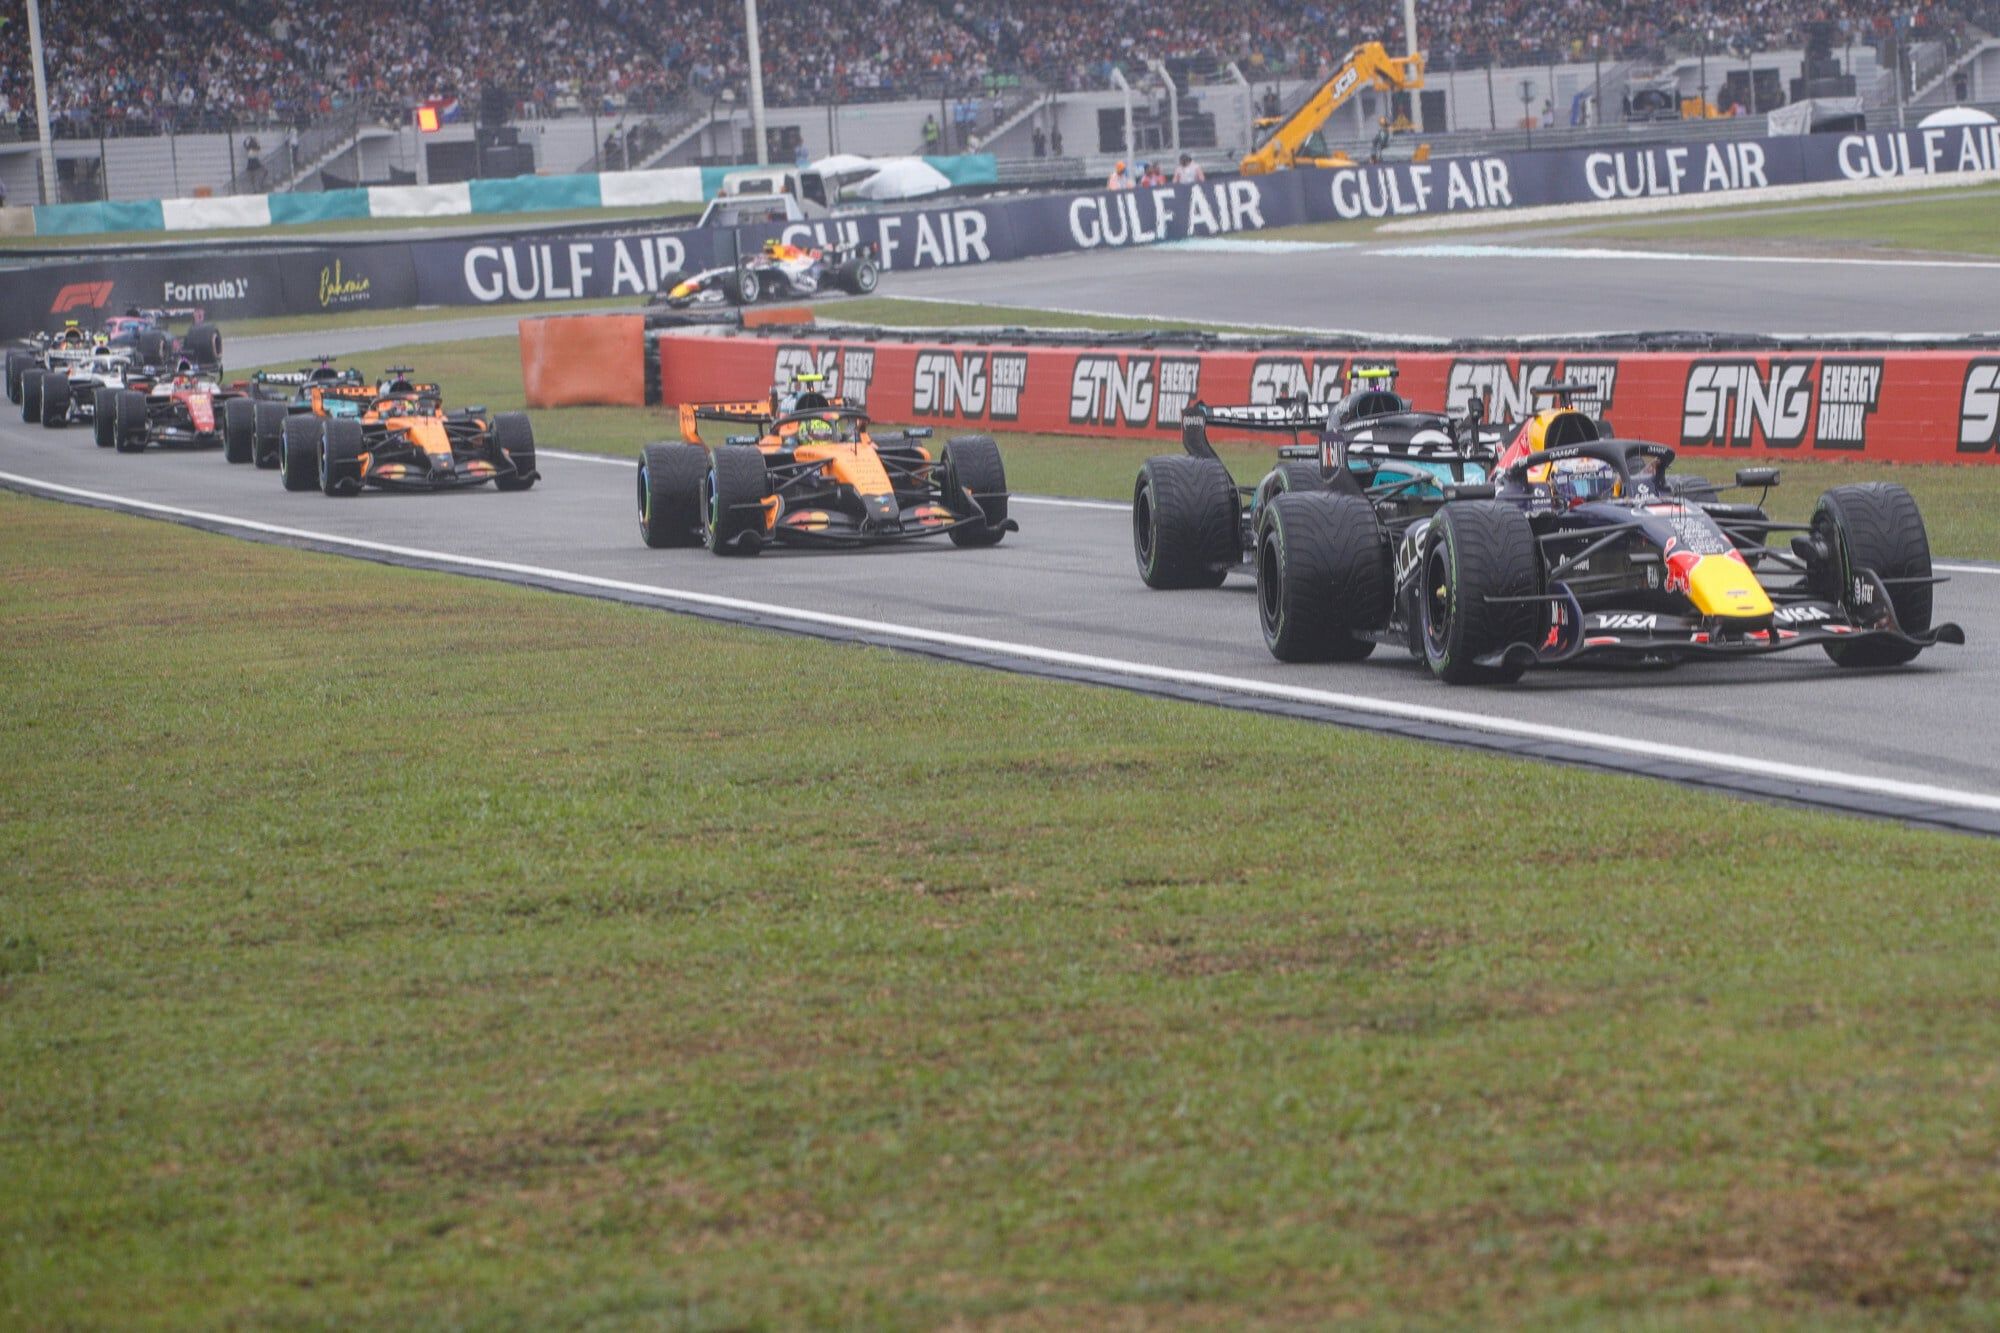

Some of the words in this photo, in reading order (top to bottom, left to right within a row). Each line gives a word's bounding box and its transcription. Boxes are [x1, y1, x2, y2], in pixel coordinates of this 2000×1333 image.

[1333, 67, 1357, 99] JCB
[1585, 147, 1689, 199] GULF
[1703, 142, 1768, 191] AIR
[1838, 128, 1946, 180] GULF
[1069, 188, 1176, 248] GULF
[1187, 180, 1266, 236] AIR
[1331, 165, 1433, 219] GULF
[1446, 158, 1514, 210] AIR
[914, 210, 990, 267] AIR
[463, 241, 595, 301] GULF
[915, 354, 986, 413] STING
[992, 351, 1027, 386] ENERGY
[991, 386, 1019, 415] DRINK
[1070, 358, 1154, 421] STING
[1160, 363, 1200, 393] ENERGY
[1448, 364, 1552, 423] STING
[1682, 364, 1811, 439] STING
[1820, 365, 1881, 403] ENERGY
[1960, 364, 2000, 443] S
[1816, 403, 1865, 440] DRINK
[1595, 613, 1658, 630] VISA
[1774, 606, 1831, 623] VISA
